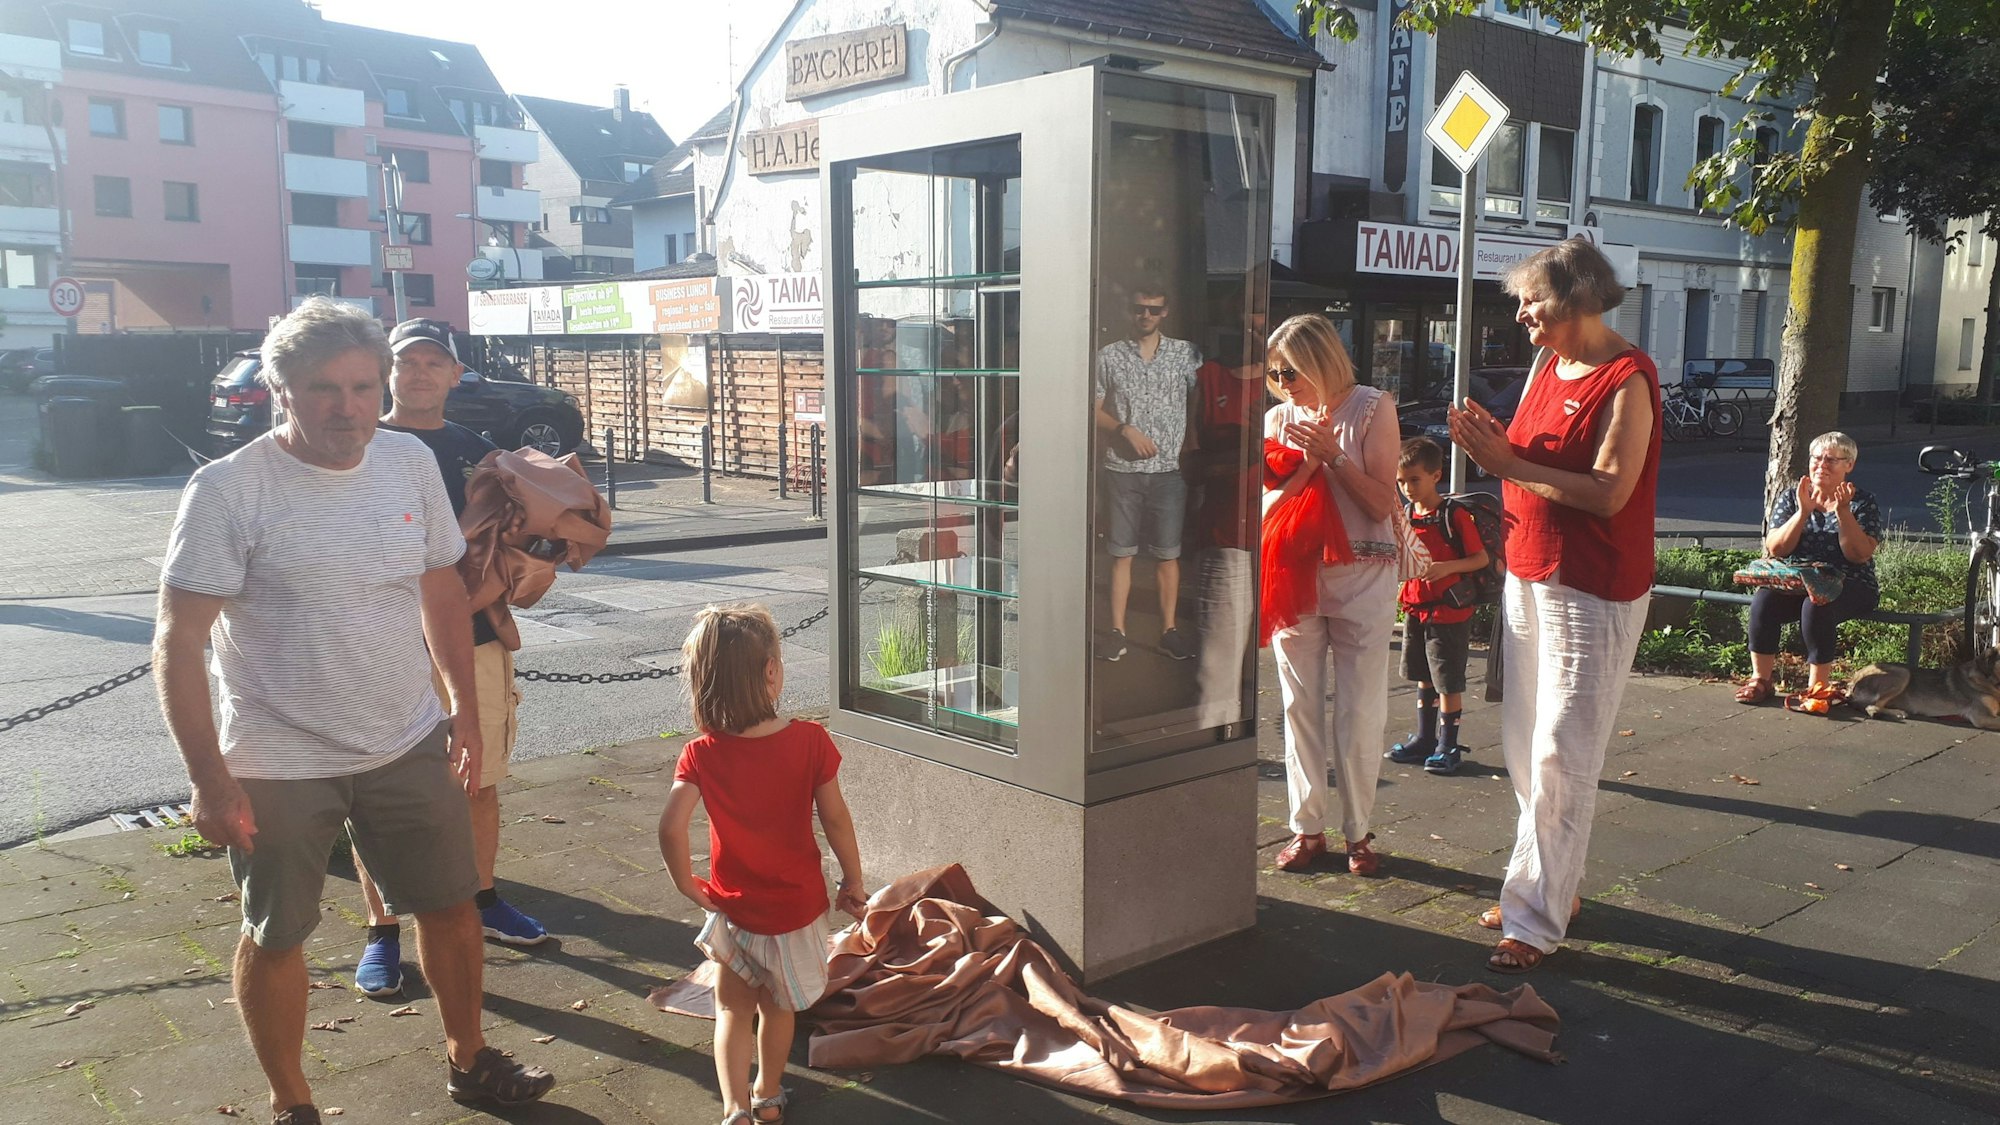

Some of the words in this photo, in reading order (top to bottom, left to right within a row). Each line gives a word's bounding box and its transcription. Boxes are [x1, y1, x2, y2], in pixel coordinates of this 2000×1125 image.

[792, 35, 899, 86] BÄCKEREI
[1387, 0, 1411, 132] AFE
[1477, 249, 1516, 264] Restaurant
[55, 288, 78, 306] 30
[655, 286, 685, 302] BUSINESS
[686, 282, 708, 298] LUNCH
[532, 309, 562, 322] TAMADA
[768, 313, 804, 325] Restaurant
[804, 313, 810, 325] &
[926, 623, 934, 642] und
[926, 645, 934, 721] Jugendteratur
